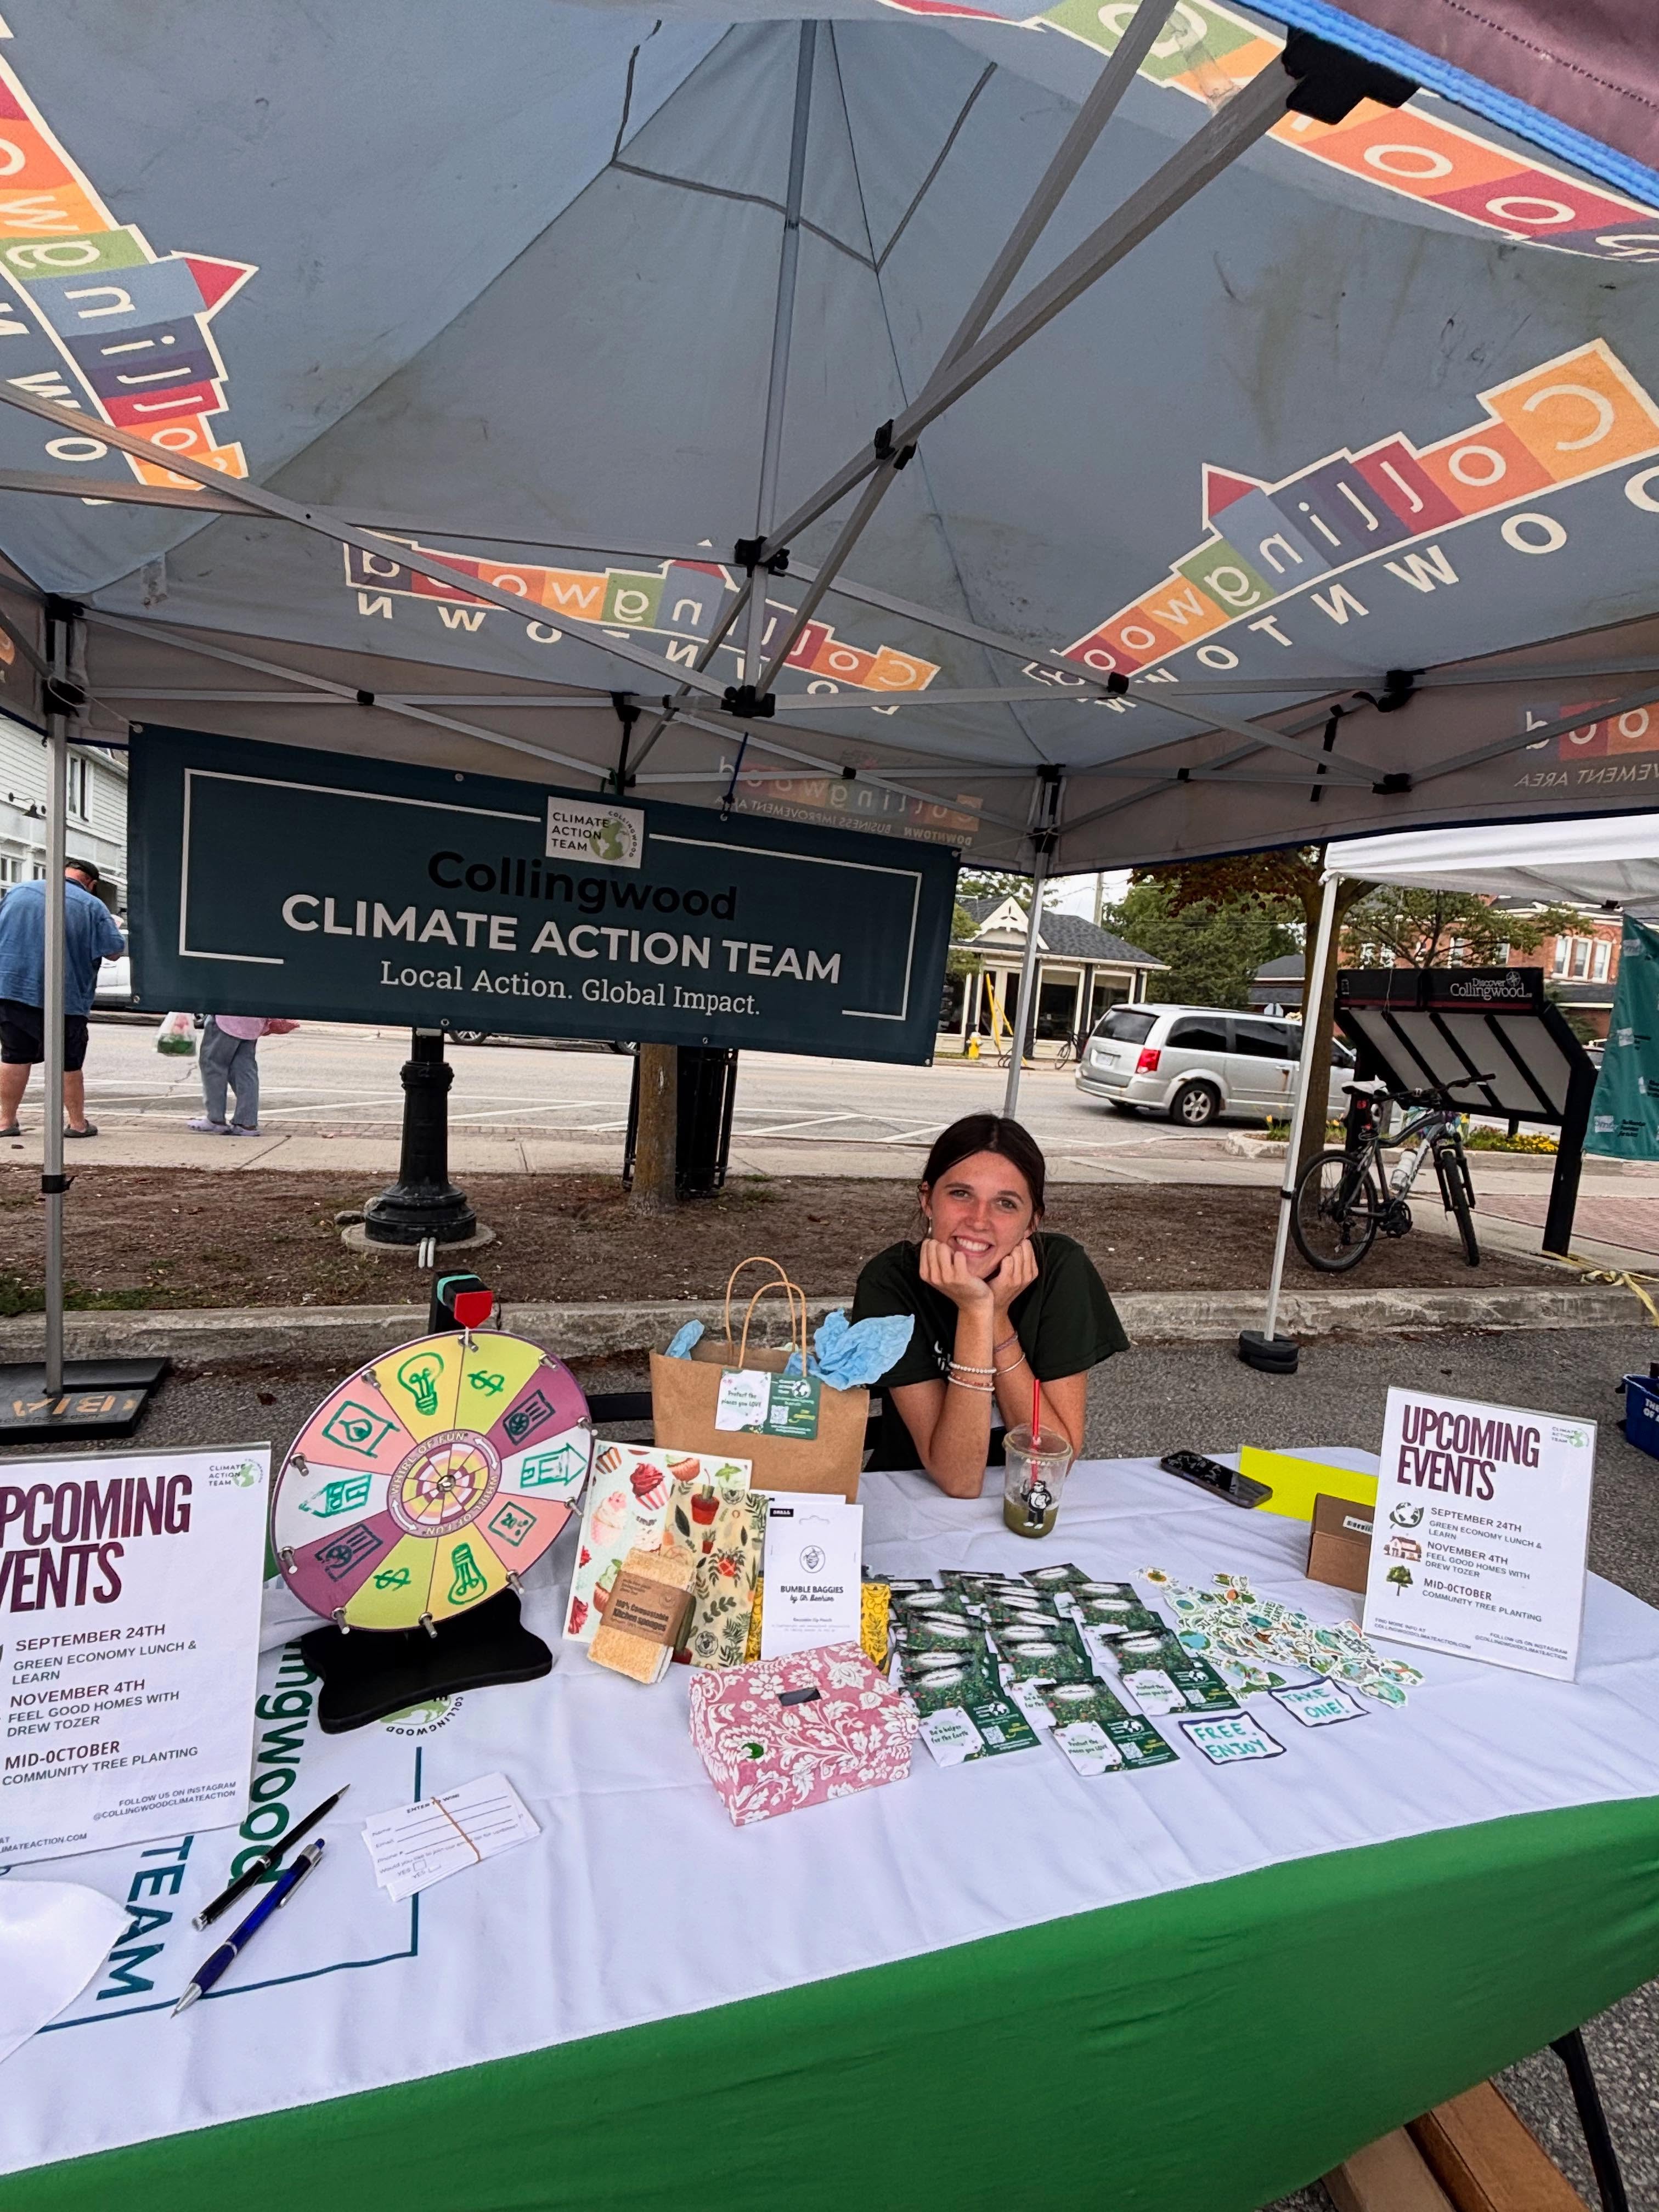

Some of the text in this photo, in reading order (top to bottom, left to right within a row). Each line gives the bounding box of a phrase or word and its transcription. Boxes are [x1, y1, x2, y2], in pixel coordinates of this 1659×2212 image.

[552, 825, 601, 839] ACTION
[553, 812, 610, 828] CLIMATE
[608, 811, 637, 857] COLLINGWOOD
[551, 838, 588, 851] TEAM
[428, 851, 737, 921] Collingwood
[283, 894, 841, 984] CLIMATE ACTION TEAM
[381, 960, 760, 1015] Local Action. Global Impact.
[1450, 982, 1525, 1001] Collingwood
[1472, 978, 1506, 987] Discover
[1643, 1408, 1655, 1418] OF
[1402, 1404, 1540, 1468] UPCOMING
[391, 1432, 465, 1494] WHIRL OF FUN
[1397, 1444, 1496, 1500] EVENTS
[426, 1476, 498, 1535] WHIRL OF FUN
[1431, 1507, 1522, 1532] SEPTEMBER 24TH
[1429, 1520, 1458, 1531] GREEN
[1460, 1527, 1502, 1540] ECONOMY
[1504, 1536, 1534, 1548] LUNCH
[1429, 1528, 1457, 1540] LEARN
[1426, 1552, 1530, 1580] FEEL GOOD HOMES WITH
[1427, 1541, 1508, 1565] NOVEMBER 4TH
[1425, 1560, 1480, 1578] DREW TOZER
[613, 1607, 637, 1623] Kitchen
[637, 1617, 667, 1632] sponges
[1422, 1590, 1542, 1622] COMMUNITY TREE PLANTING
[15, 1623, 166, 1652] SEPTEMBER 24TH
[13, 1640, 197, 1671] GREEN ECONOMY LUNCH &
[12, 1670, 60, 1685] LEARN
[8, 1691, 179, 1723] FEEL GOOD HOMES WITH
[10, 1679, 145, 1708] NOVEMBER 4TH
[1281, 1688, 1330, 1702] TAKE
[386, 1696, 464, 1736] COLLINGWOOD
[1304, 1698, 1350, 1718] ONE!
[7, 1716, 100, 1737] DREW TOZER
[1205, 1739, 1268, 1758] ENJOY
[2, 1746, 199, 1786] COMMUNITY TREE PLANTING
[93, 1790, 236, 1821] @COLLINGWOODCLIMATEACTION
[119, 1794, 157, 1807] FOLLOW
[187, 1781, 236, 1795] INSTAGRAM
[407, 1802, 431, 1814] ENTER
[96, 1835, 194, 2001] TEAM
